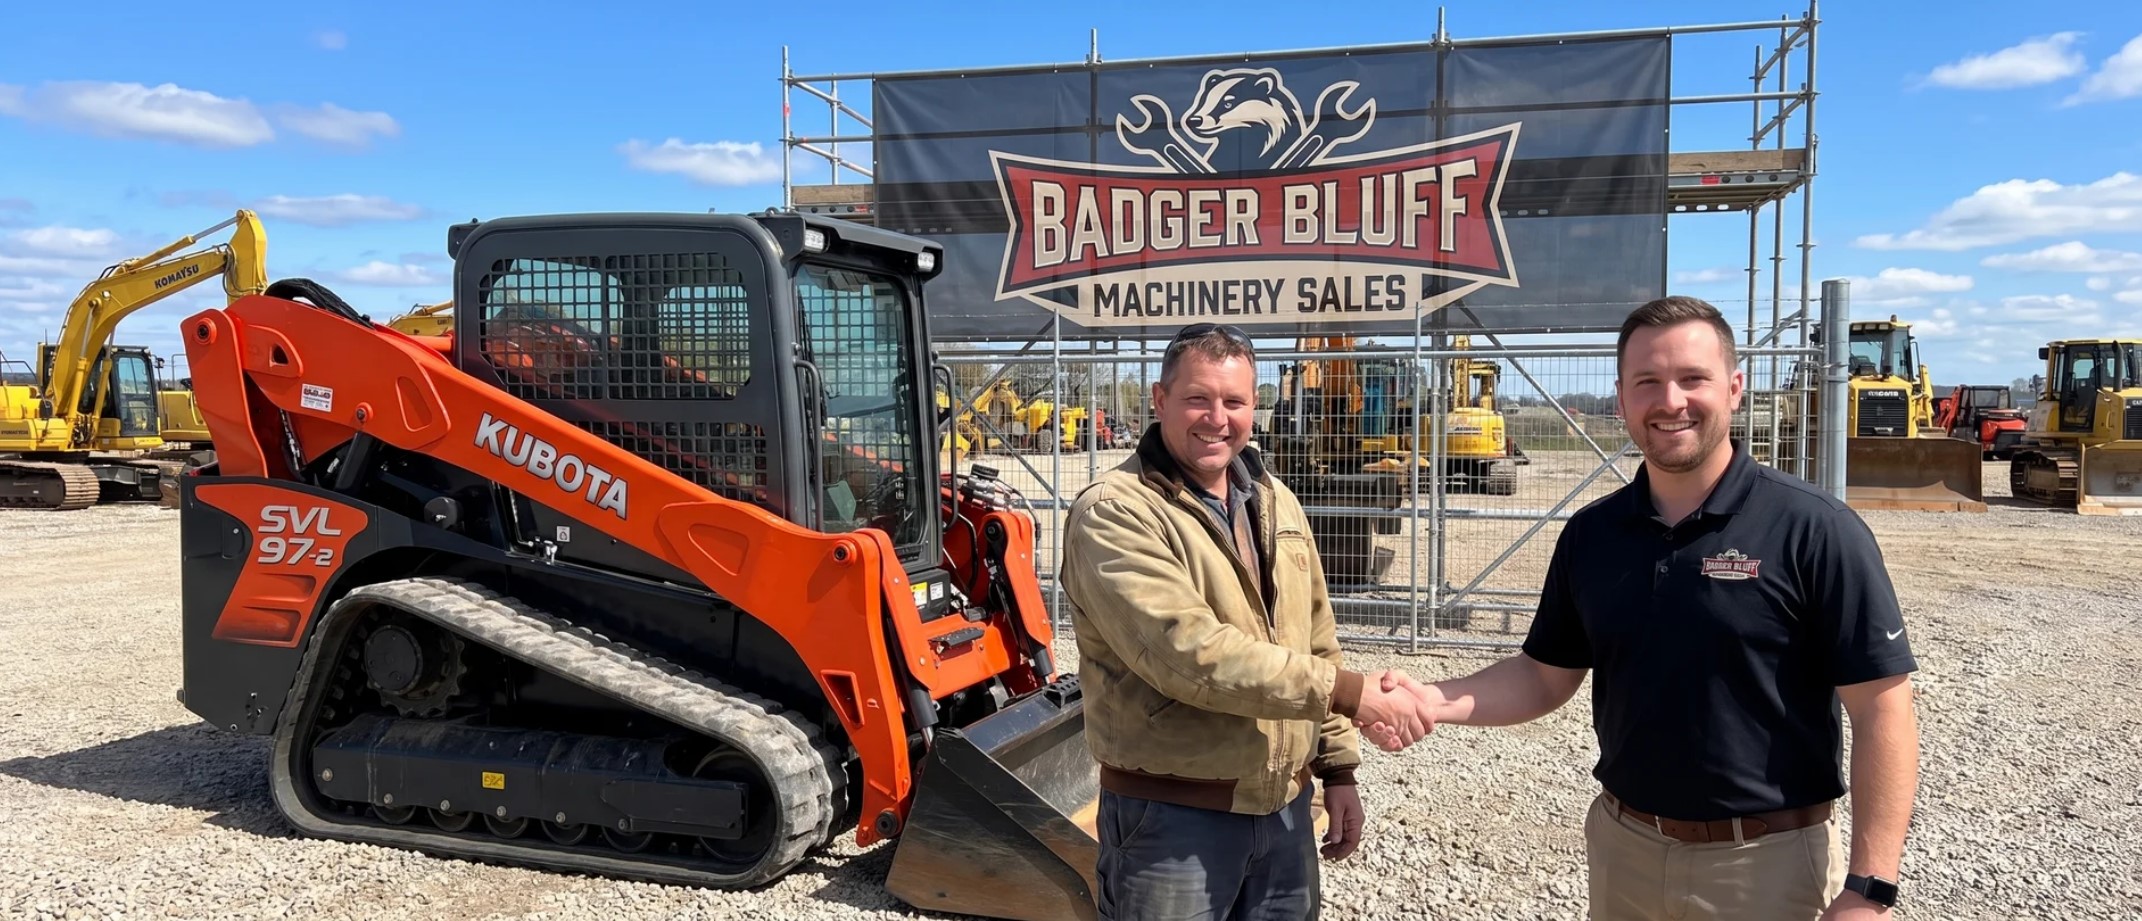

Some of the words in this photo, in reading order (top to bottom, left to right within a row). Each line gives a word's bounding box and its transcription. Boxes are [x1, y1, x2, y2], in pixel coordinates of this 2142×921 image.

[1031, 179, 1262, 270] BADGER
[1282, 156, 1479, 253] BLUFF
[1093, 278, 1285, 318] MACHINERY
[1297, 274, 1406, 313] SALES
[474, 411, 628, 521] KUBOTA
[258, 505, 341, 536] SVL
[258, 537, 334, 566] 97-2
